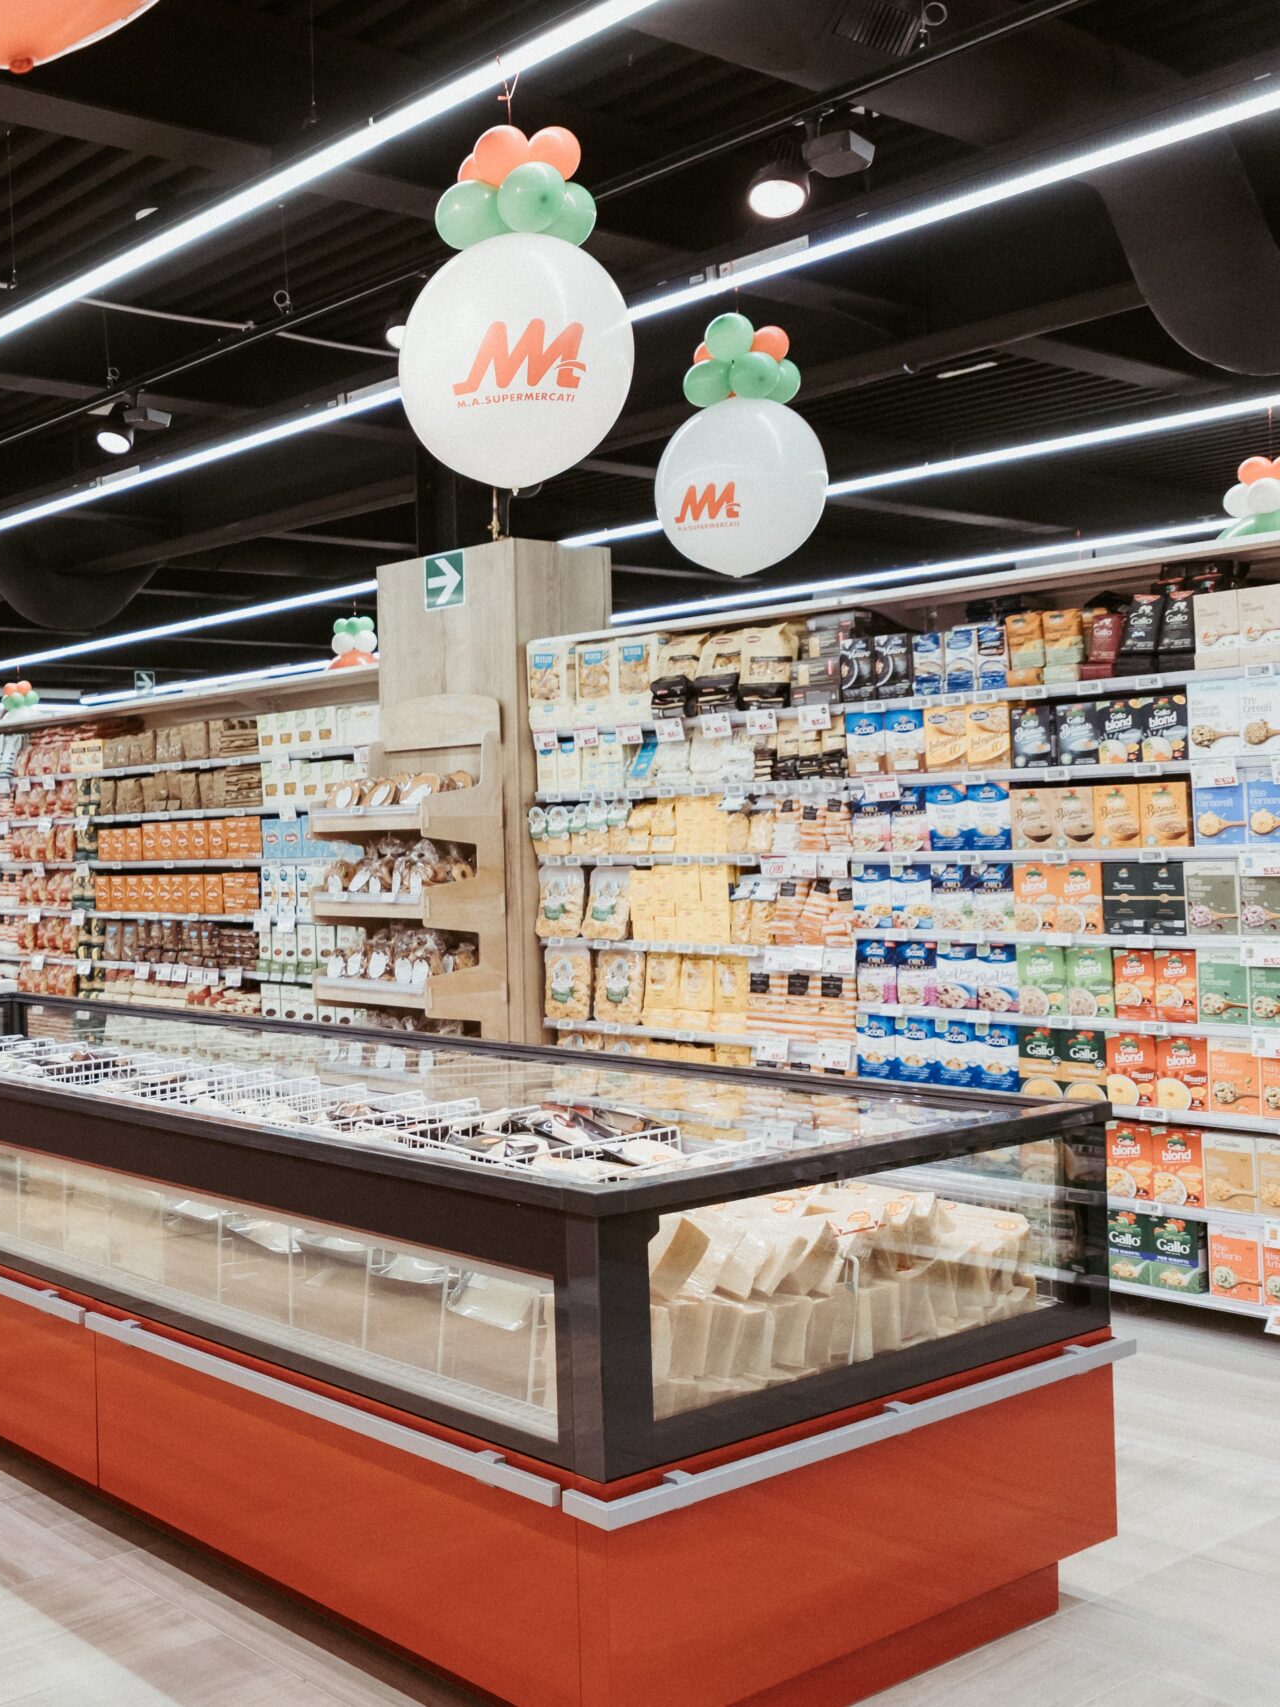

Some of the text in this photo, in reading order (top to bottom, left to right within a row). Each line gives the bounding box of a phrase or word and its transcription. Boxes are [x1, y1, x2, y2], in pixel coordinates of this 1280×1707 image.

[1130, 616, 1152, 625] Gallo
[1166, 614, 1188, 623] Gallo
[1105, 714, 1132, 731] blond
[1149, 711, 1177, 728] blond
[864, 1027, 886, 1037] Scotti
[904, 1029, 925, 1039] Scotti
[944, 1032, 966, 1042] Scotti
[985, 1036, 1008, 1046] Scotti
[1026, 1044, 1055, 1056] Gallo
[1069, 1047, 1098, 1060] Gallo
[1114, 1050, 1144, 1064] blond
[1166, 1053, 1196, 1067] blond
[1112, 1144, 1140, 1156] blond
[1161, 1149, 1191, 1161] blond
[1109, 1231, 1141, 1246] Gallo
[1156, 1239, 1190, 1254] Gallo
